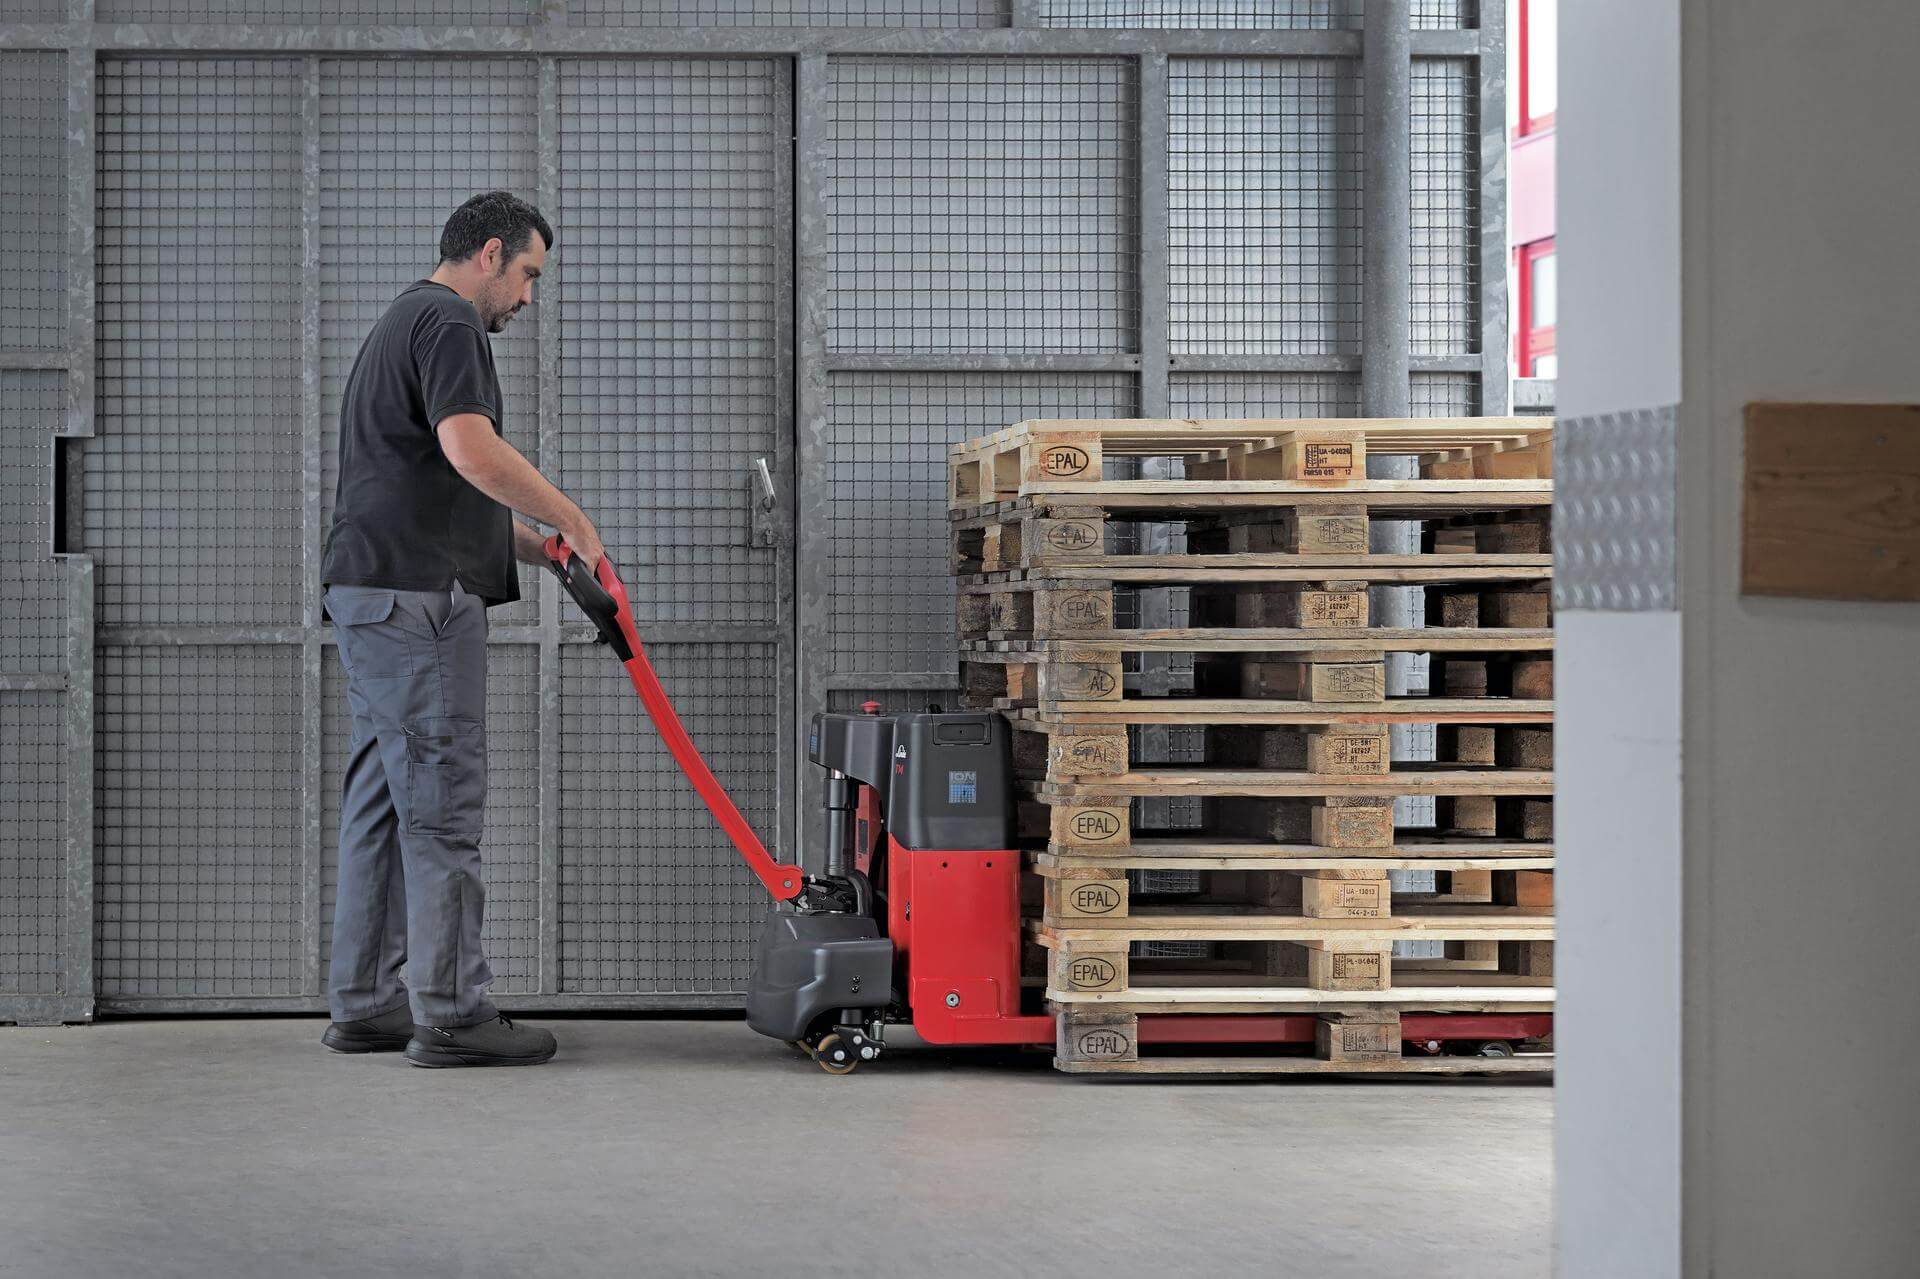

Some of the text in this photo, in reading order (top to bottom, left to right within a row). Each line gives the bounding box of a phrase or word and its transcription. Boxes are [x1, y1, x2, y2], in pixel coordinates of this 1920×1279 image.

[1047, 453, 1082, 469] EPAL
[1067, 602, 1103, 618] EPAL
[1078, 818, 1113, 833] EPAL
[1078, 891, 1113, 907] EPAL
[1073, 965, 1108, 980] EPAL
[1086, 1037, 1121, 1054] EPAL
